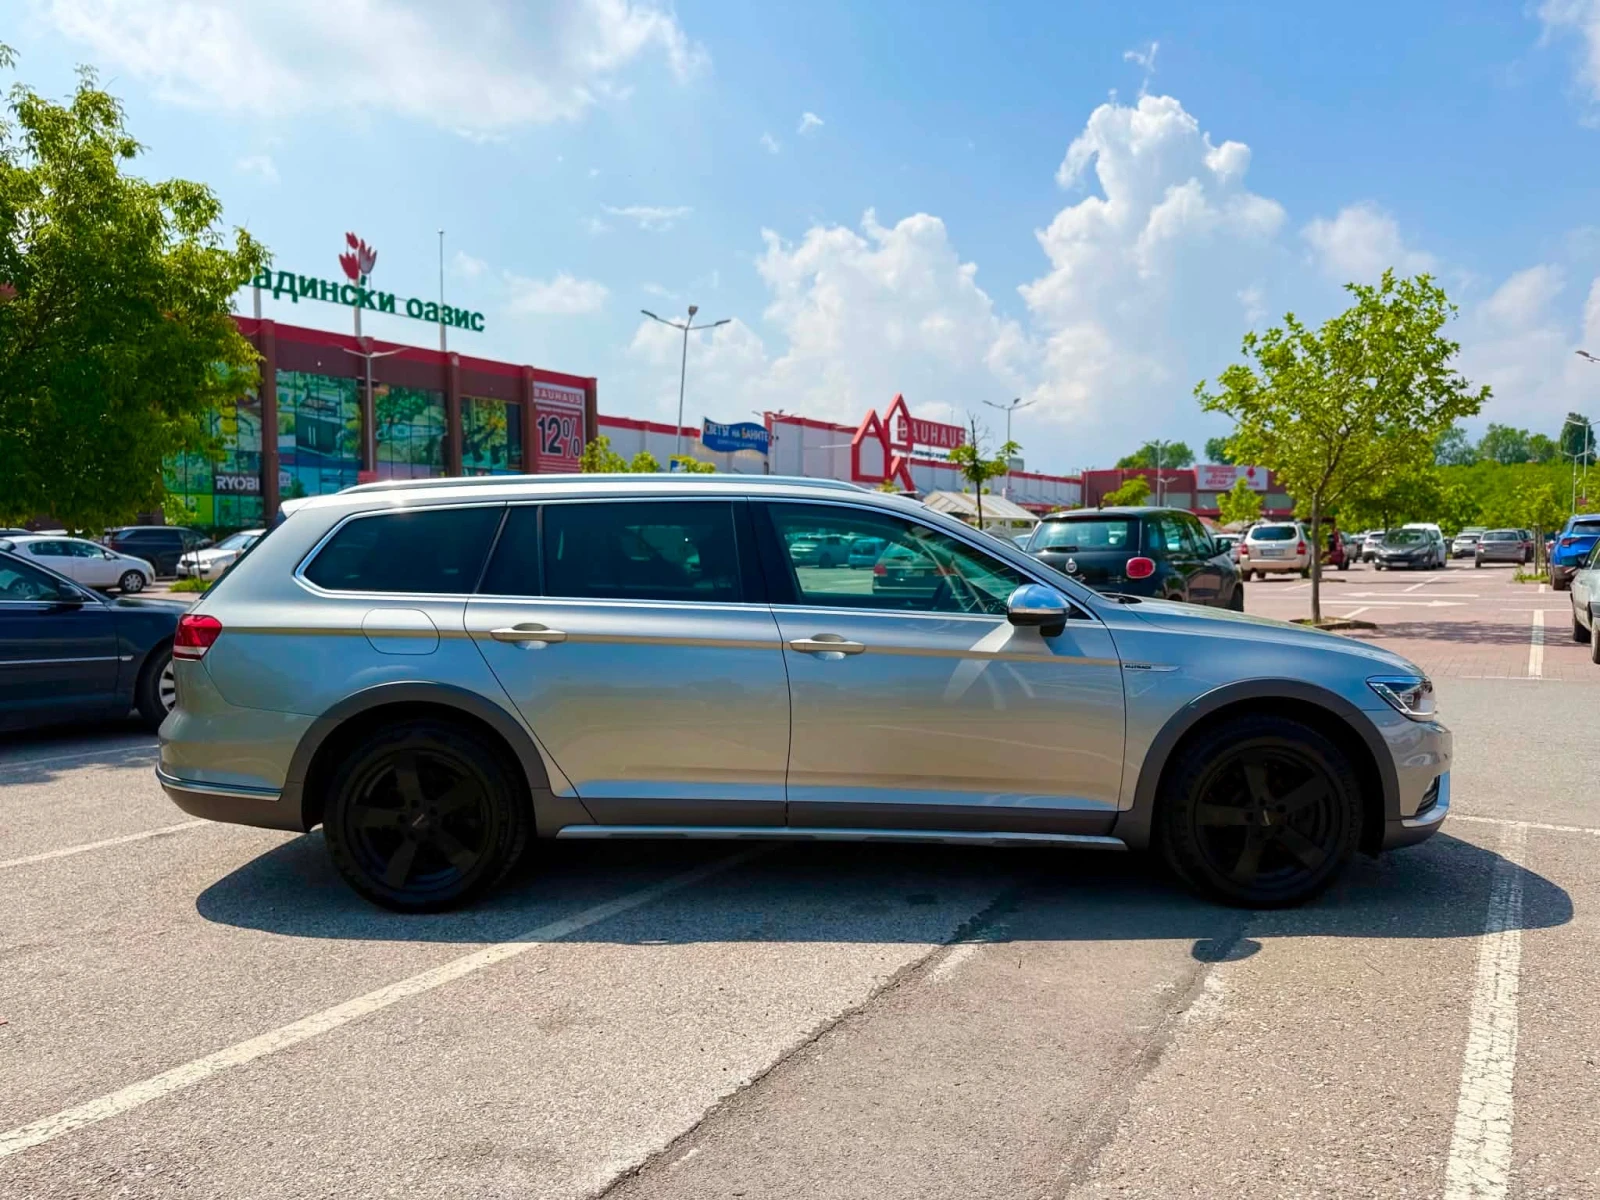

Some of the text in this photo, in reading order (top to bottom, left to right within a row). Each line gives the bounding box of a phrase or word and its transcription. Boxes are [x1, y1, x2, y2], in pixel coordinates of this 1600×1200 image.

[241, 265, 486, 333] адински оазис
[533, 387, 582, 405] BAUHAUS
[536, 413, 582, 460] 12%
[214, 474, 261, 492] RYOBI
